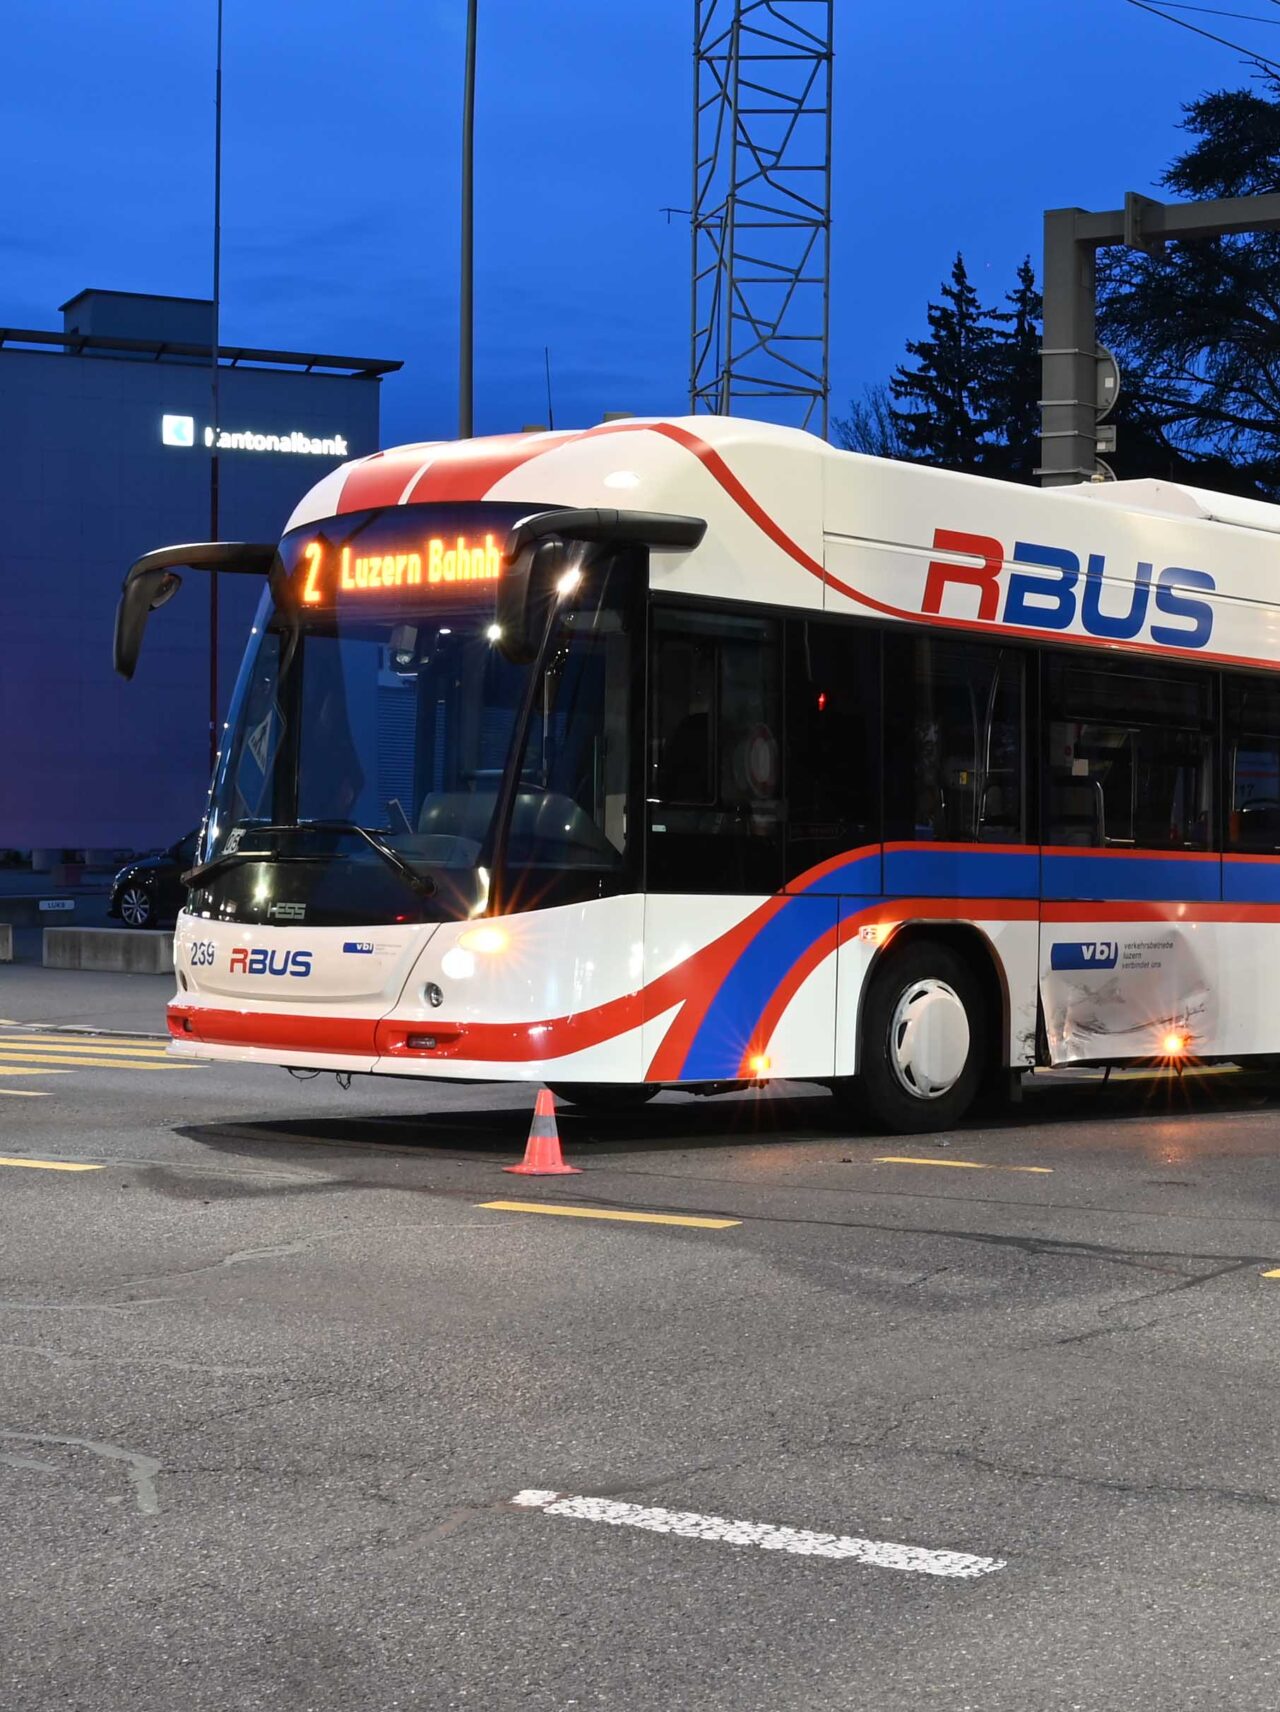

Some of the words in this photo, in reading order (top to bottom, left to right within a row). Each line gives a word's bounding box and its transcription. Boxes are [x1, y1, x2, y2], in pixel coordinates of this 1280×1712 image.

[304, 542, 322, 602] 2
[341, 547, 422, 589] Luzern
[428, 534, 503, 583] Bahnh
[921, 528, 1216, 648] RBUS
[267, 902, 306, 920] HESS
[190, 941, 215, 966] 239
[356, 942, 373, 951] vbl
[1081, 942, 1116, 960] vbl
[1123, 941, 1174, 950] verkehrsbetriebe
[229, 948, 313, 977] RBUS
[1122, 951, 1142, 960] luzern
